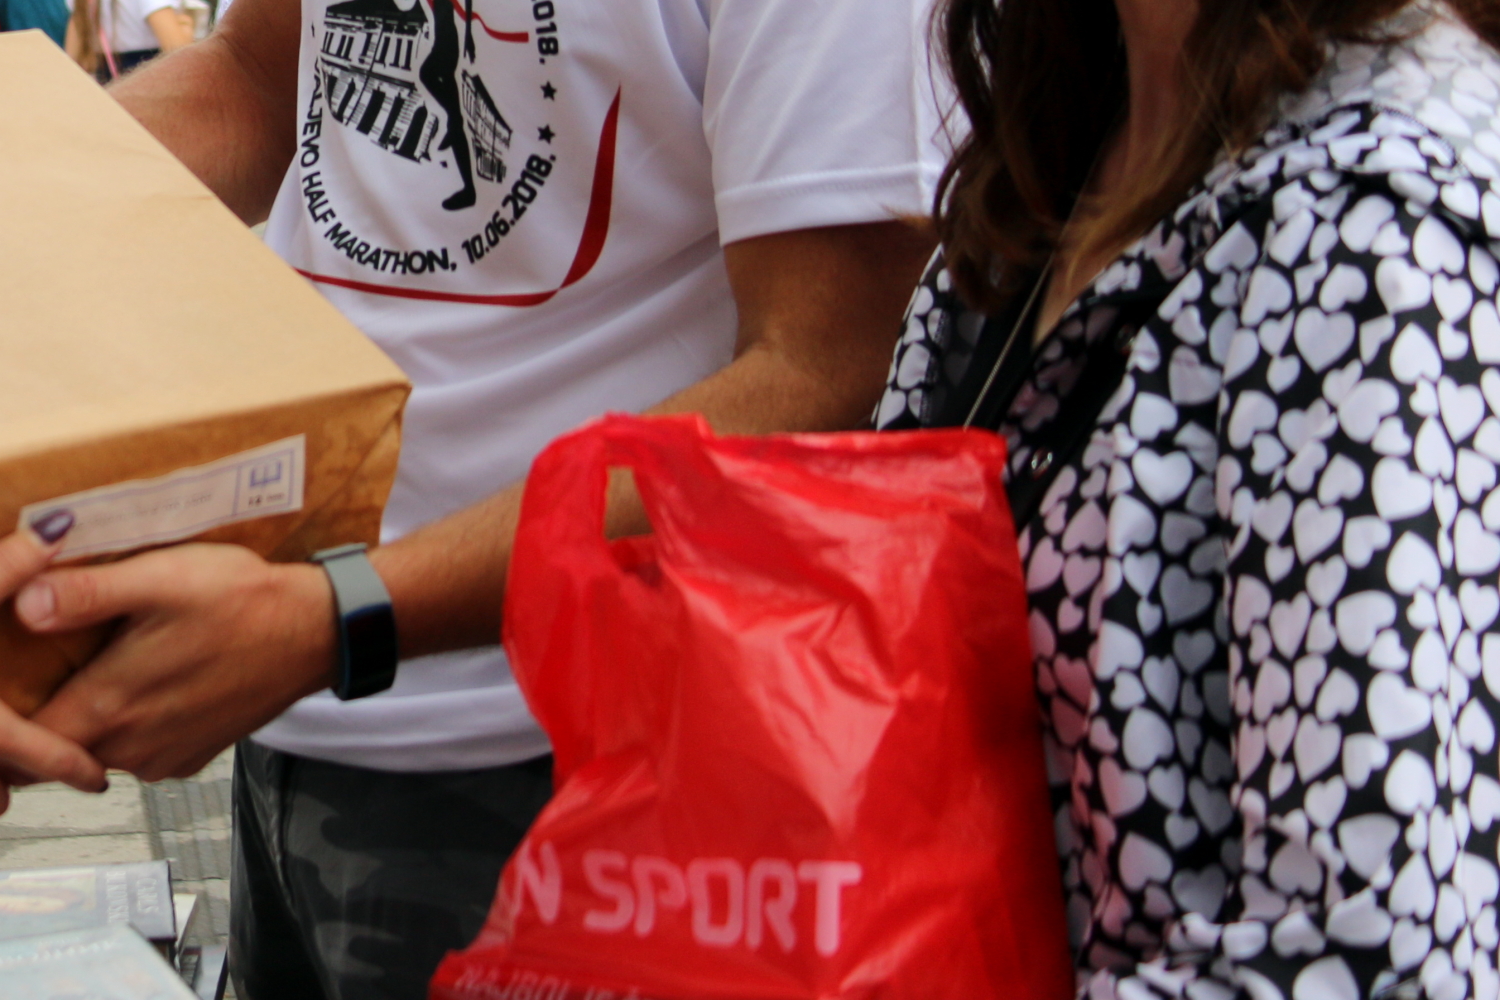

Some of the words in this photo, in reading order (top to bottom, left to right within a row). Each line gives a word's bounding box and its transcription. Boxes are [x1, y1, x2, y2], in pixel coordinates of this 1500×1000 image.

[302, 171, 337, 223] HALF
[324, 222, 457, 275] MARATHON,
[462, 154, 557, 264] 10.06.2018.
[581, 849, 862, 957] SPORT
